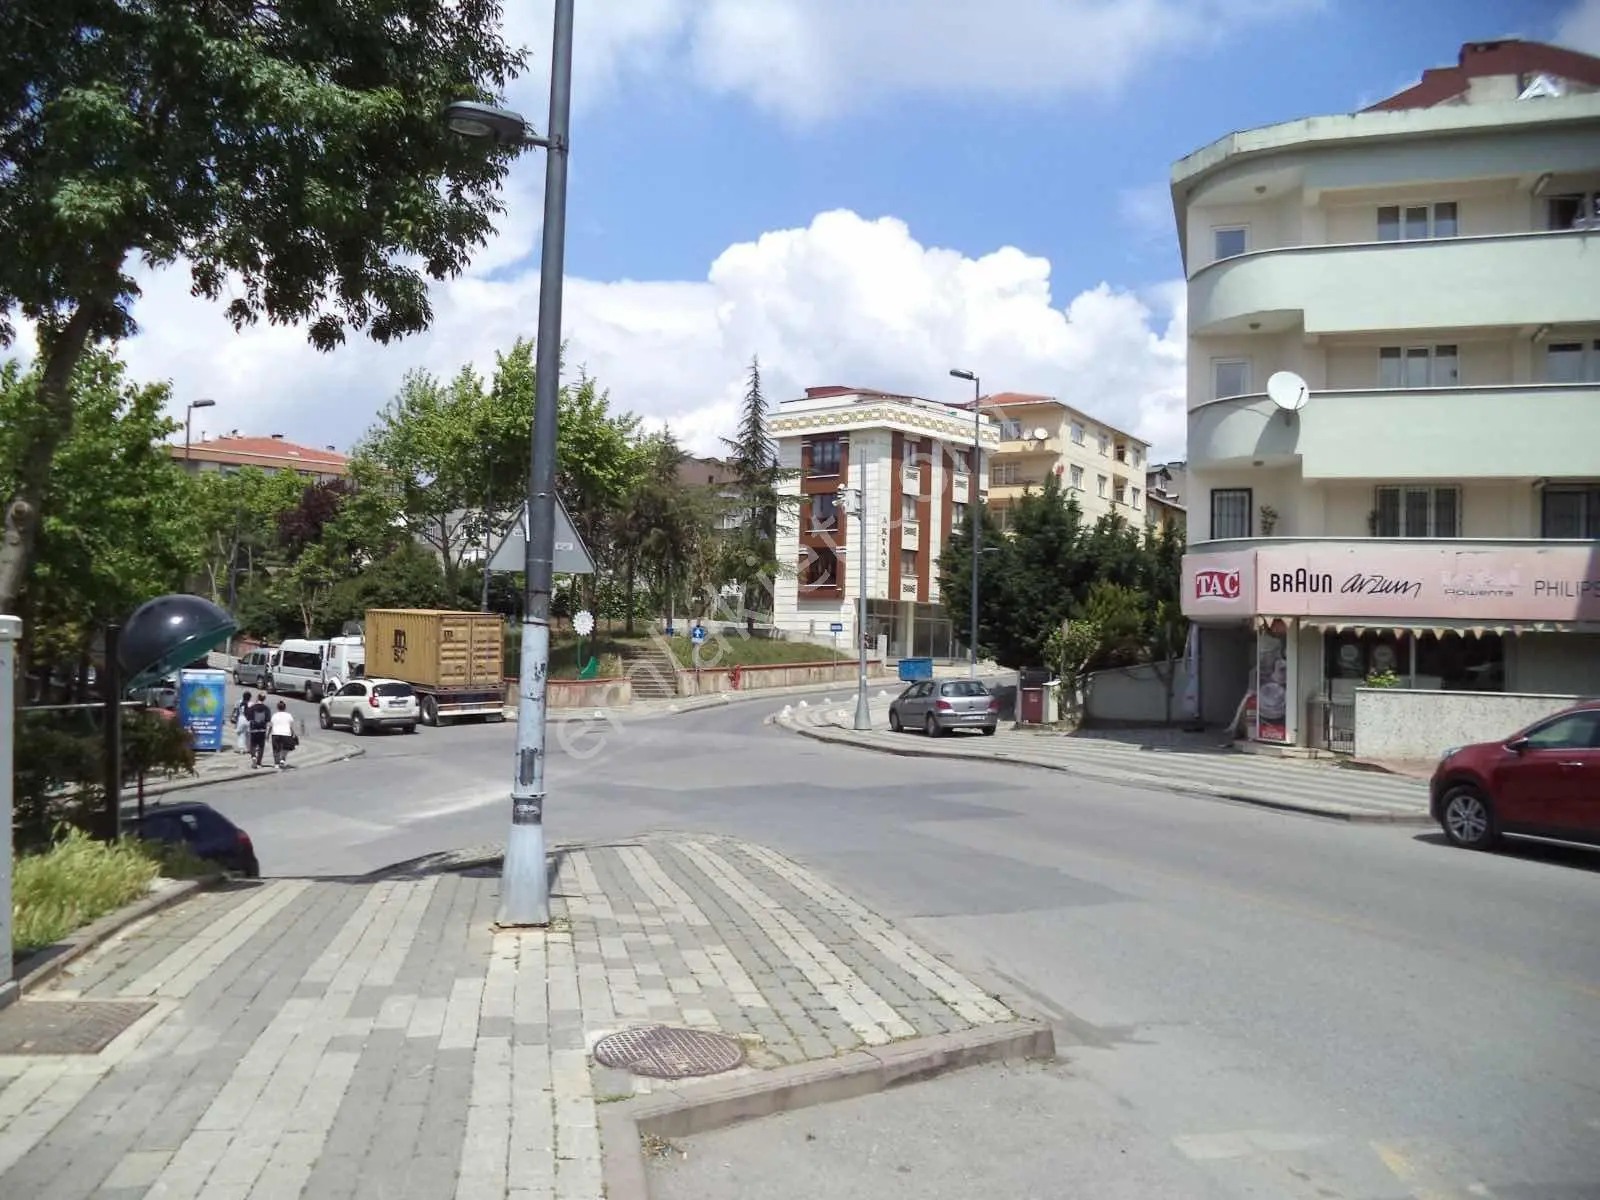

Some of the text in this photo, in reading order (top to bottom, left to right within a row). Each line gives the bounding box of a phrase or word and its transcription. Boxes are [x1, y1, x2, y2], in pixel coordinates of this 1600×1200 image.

[1270, 568, 1333, 593] BRAUN
[1340, 573, 1422, 598] arzum
[1534, 580, 1600, 598] PHILIPS
